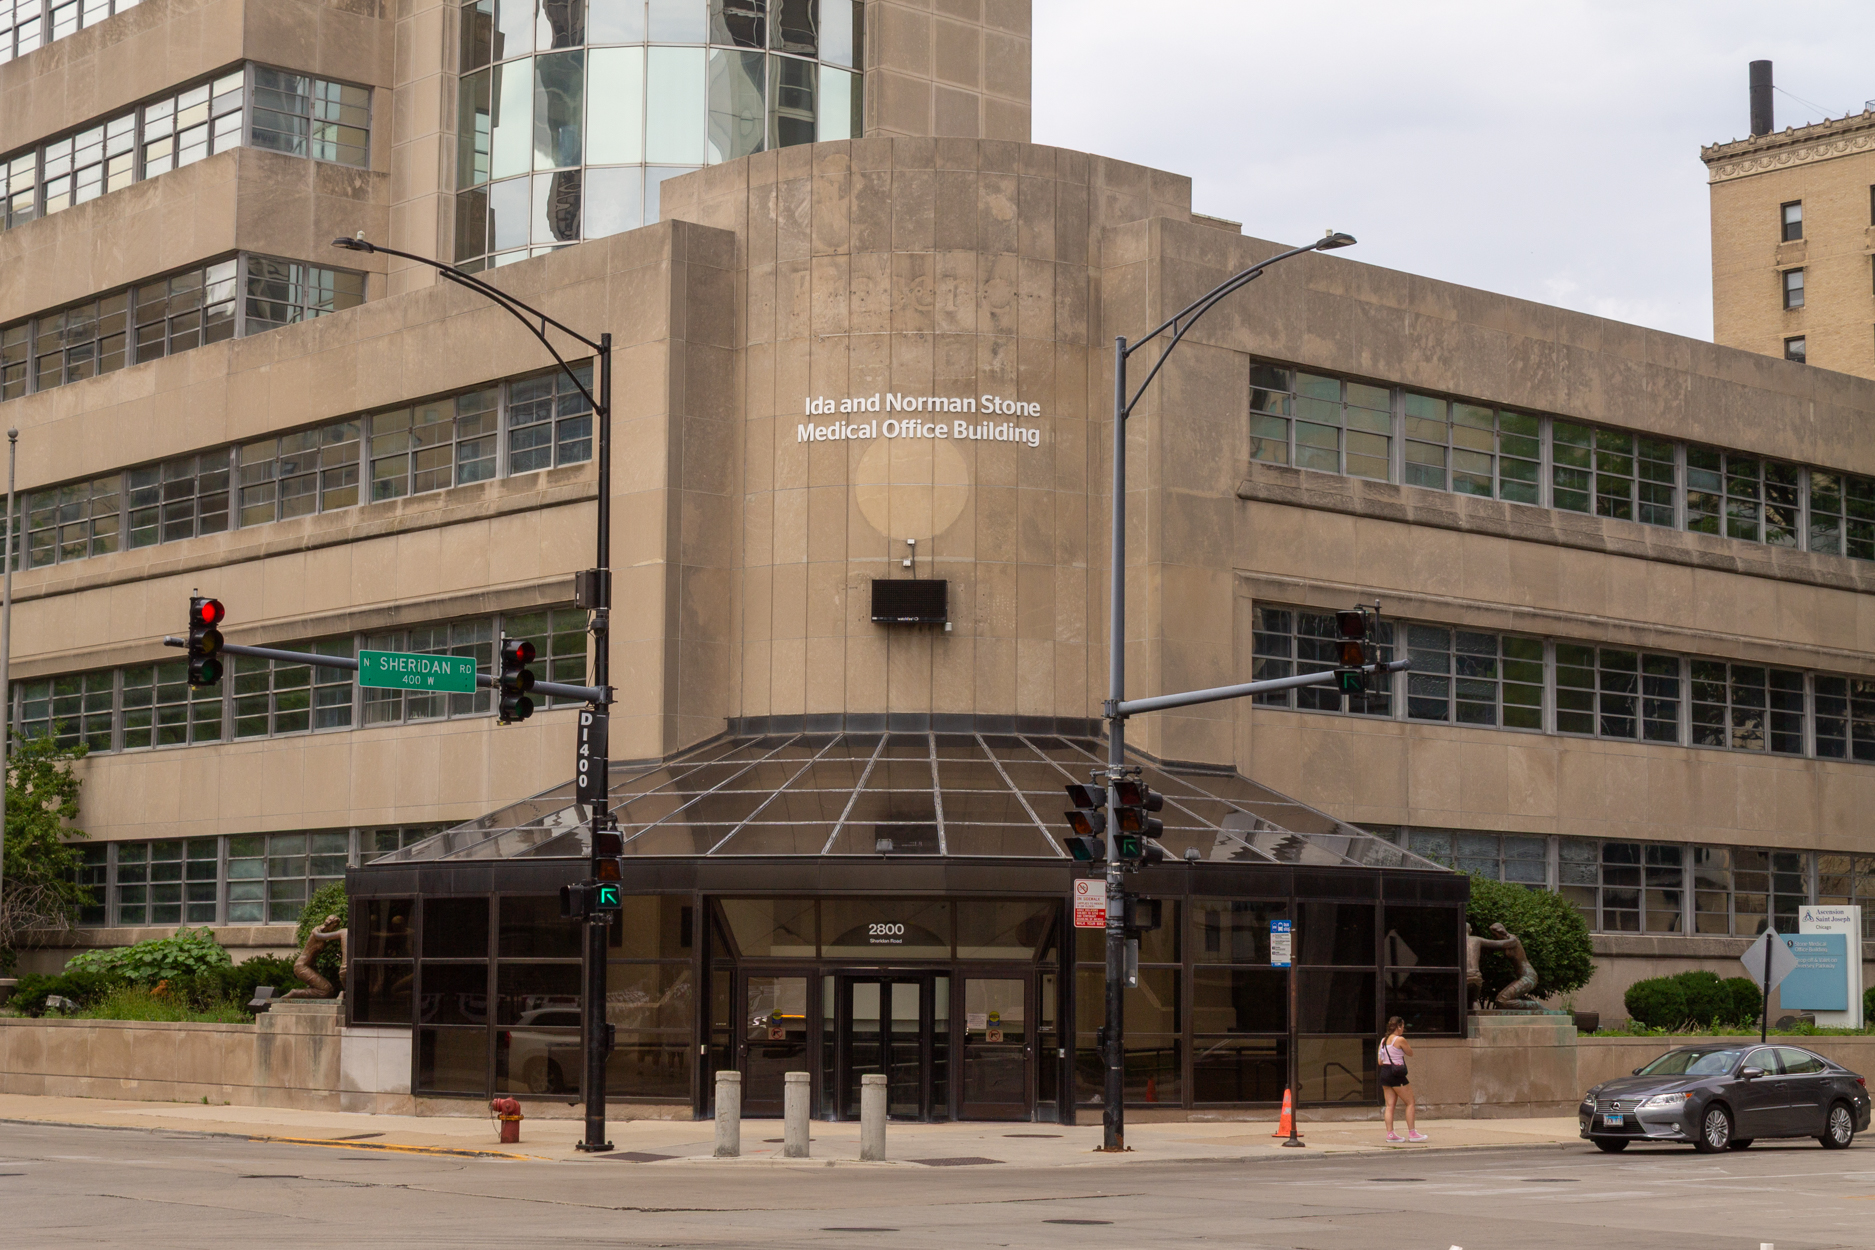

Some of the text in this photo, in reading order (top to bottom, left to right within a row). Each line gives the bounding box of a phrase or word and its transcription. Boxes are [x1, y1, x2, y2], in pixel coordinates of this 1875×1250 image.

[805, 393, 1041, 417] Ida and Norman Stone
[797, 419, 1041, 447] Medical Office Building
[363, 657, 472, 674] N SHERIDAN RD
[402, 675, 435, 686] 400 W
[869, 924, 904, 935] 2800
